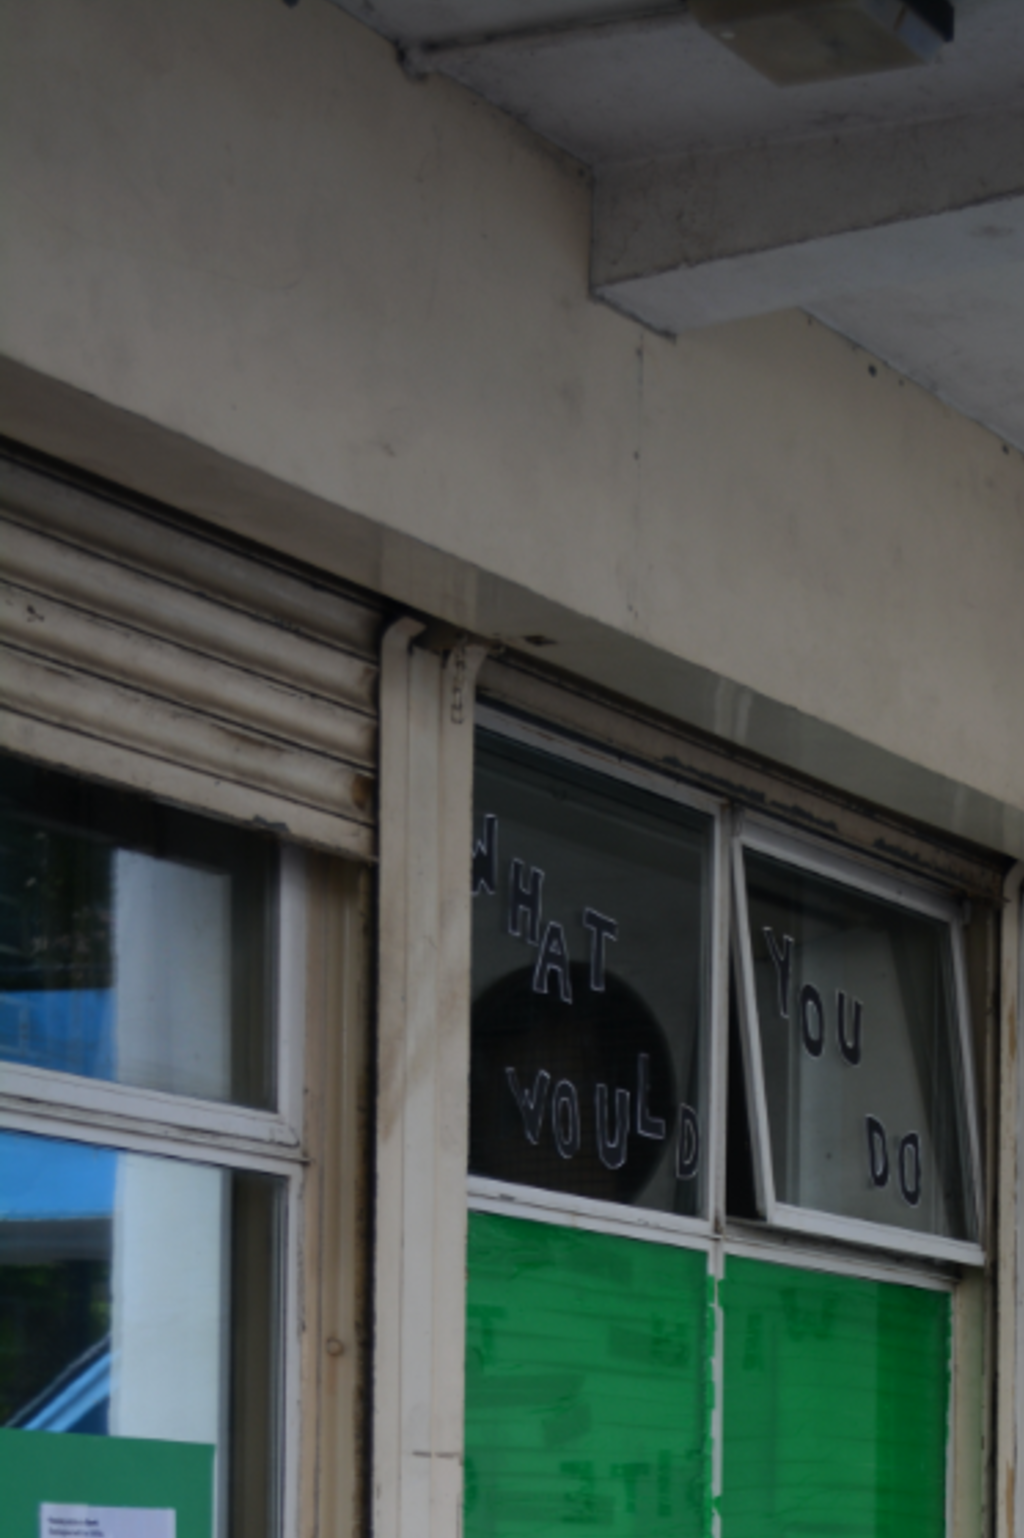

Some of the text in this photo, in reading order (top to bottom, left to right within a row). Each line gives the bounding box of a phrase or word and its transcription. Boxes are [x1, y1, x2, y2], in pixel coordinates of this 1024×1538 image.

[763, 926, 864, 1067] YOU
[505, 1053, 700, 1180] WOULD
[866, 1113, 922, 1206] DO
